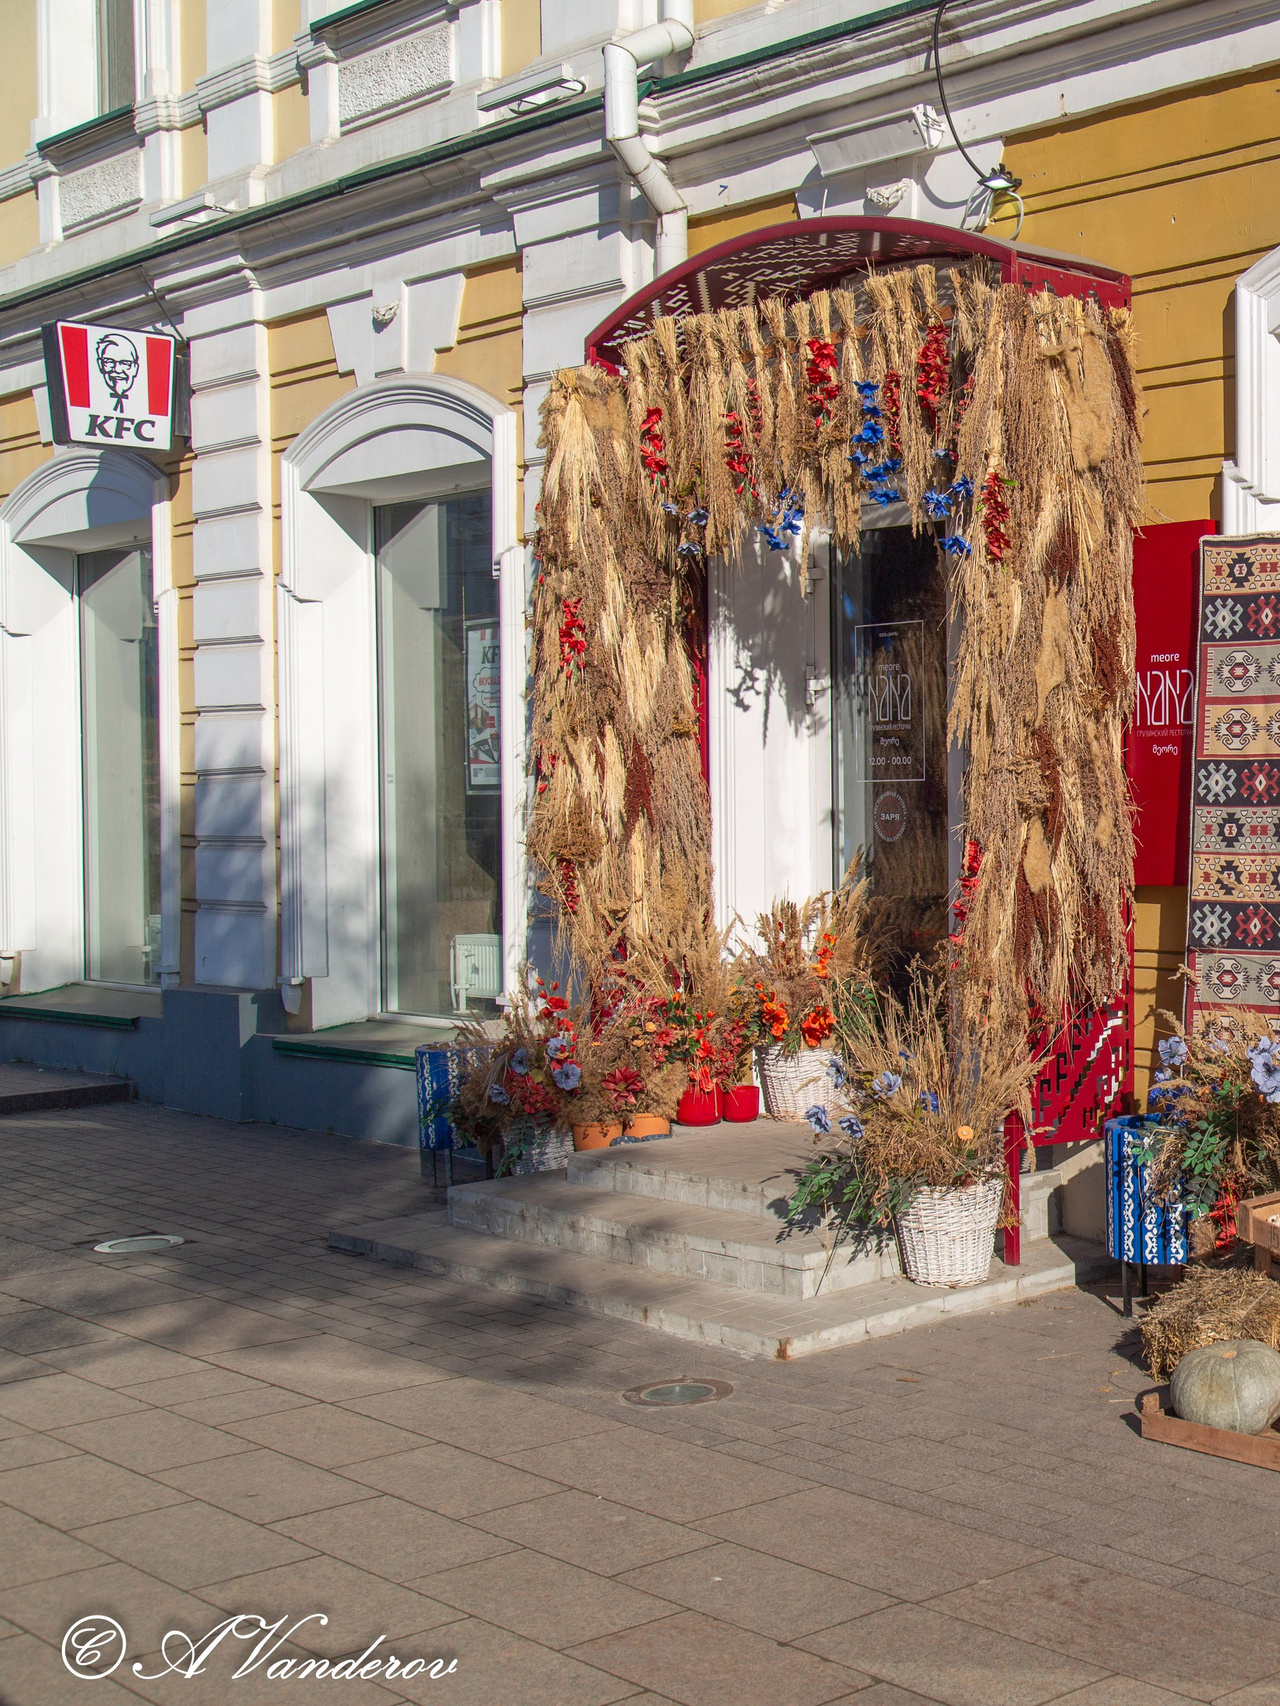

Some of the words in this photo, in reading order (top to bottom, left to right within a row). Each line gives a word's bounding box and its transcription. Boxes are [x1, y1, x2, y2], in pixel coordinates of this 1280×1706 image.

[85, 414, 156, 442] KFC
[481, 645, 501, 664] KF
[1150, 653, 1180, 663] meore
[878, 663, 900, 671] meore
[1136, 728, 1168, 737] ГРУЗИНСКИЙ
[868, 757, 886, 766] 12.00
[891, 756, 912, 765] 00.00
[880, 813, 900, 821] ЗАРЯ
